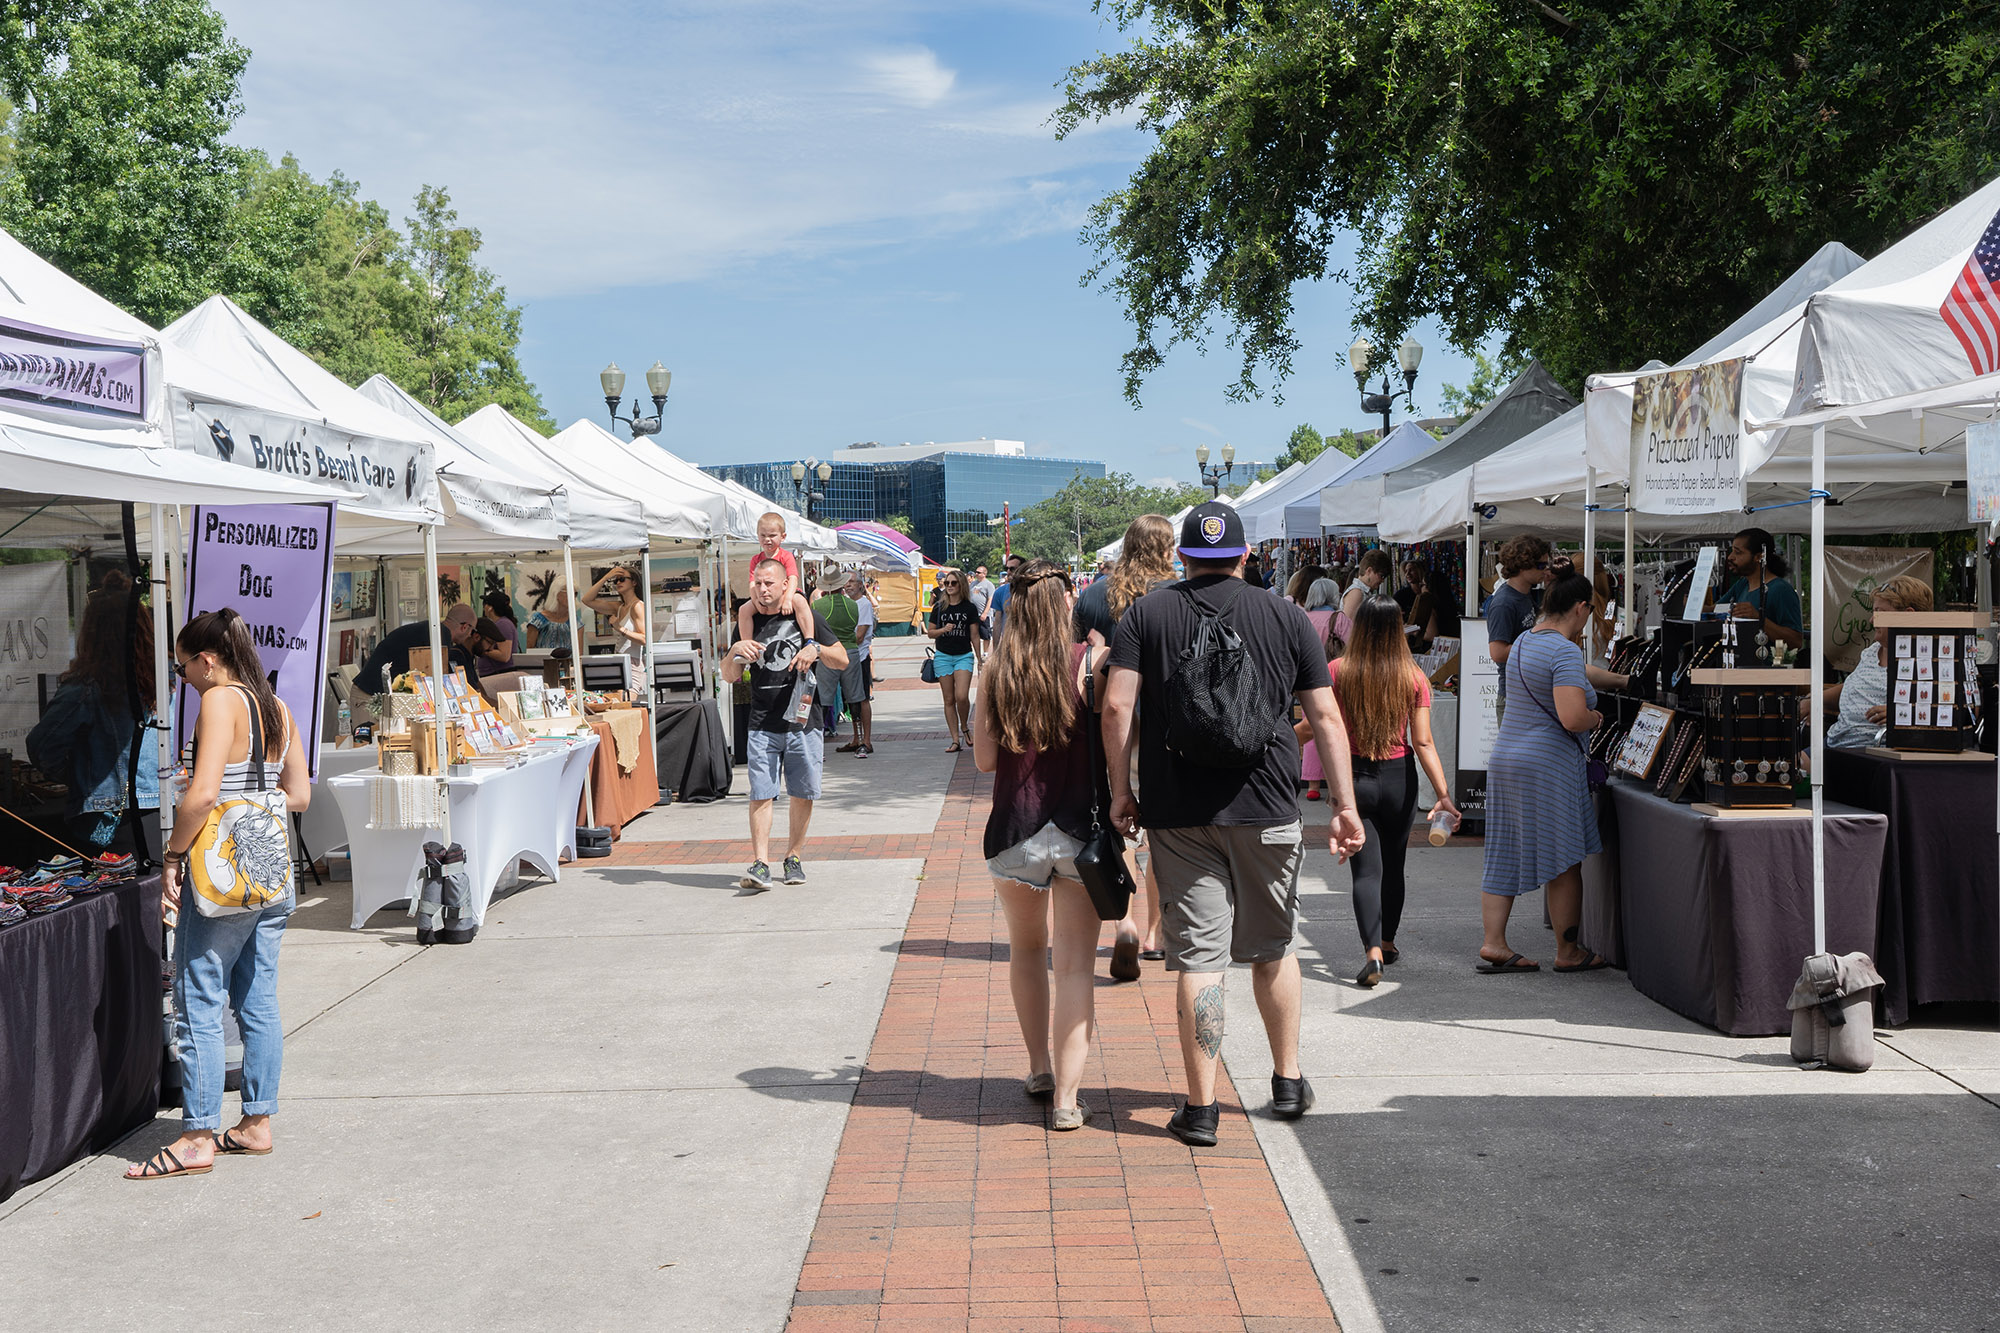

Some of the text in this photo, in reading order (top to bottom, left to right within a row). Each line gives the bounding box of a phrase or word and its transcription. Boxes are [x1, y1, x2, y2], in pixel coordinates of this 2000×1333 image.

[249, 434, 396, 489] Brott's Beard Care
[1647, 424, 1739, 476] Pizzazzed Paper
[1645, 472, 1679, 490] Handcrafted
[1682, 472, 1699, 493] Paper
[1700, 472, 1716, 490] Bead
[205, 512, 319, 550] PERSONALIZED
[239, 564, 273, 598] DOG
[941, 613, 968, 621] CATS
[1479, 685, 1498, 695] ASK
[1483, 699, 1497, 709] TA
